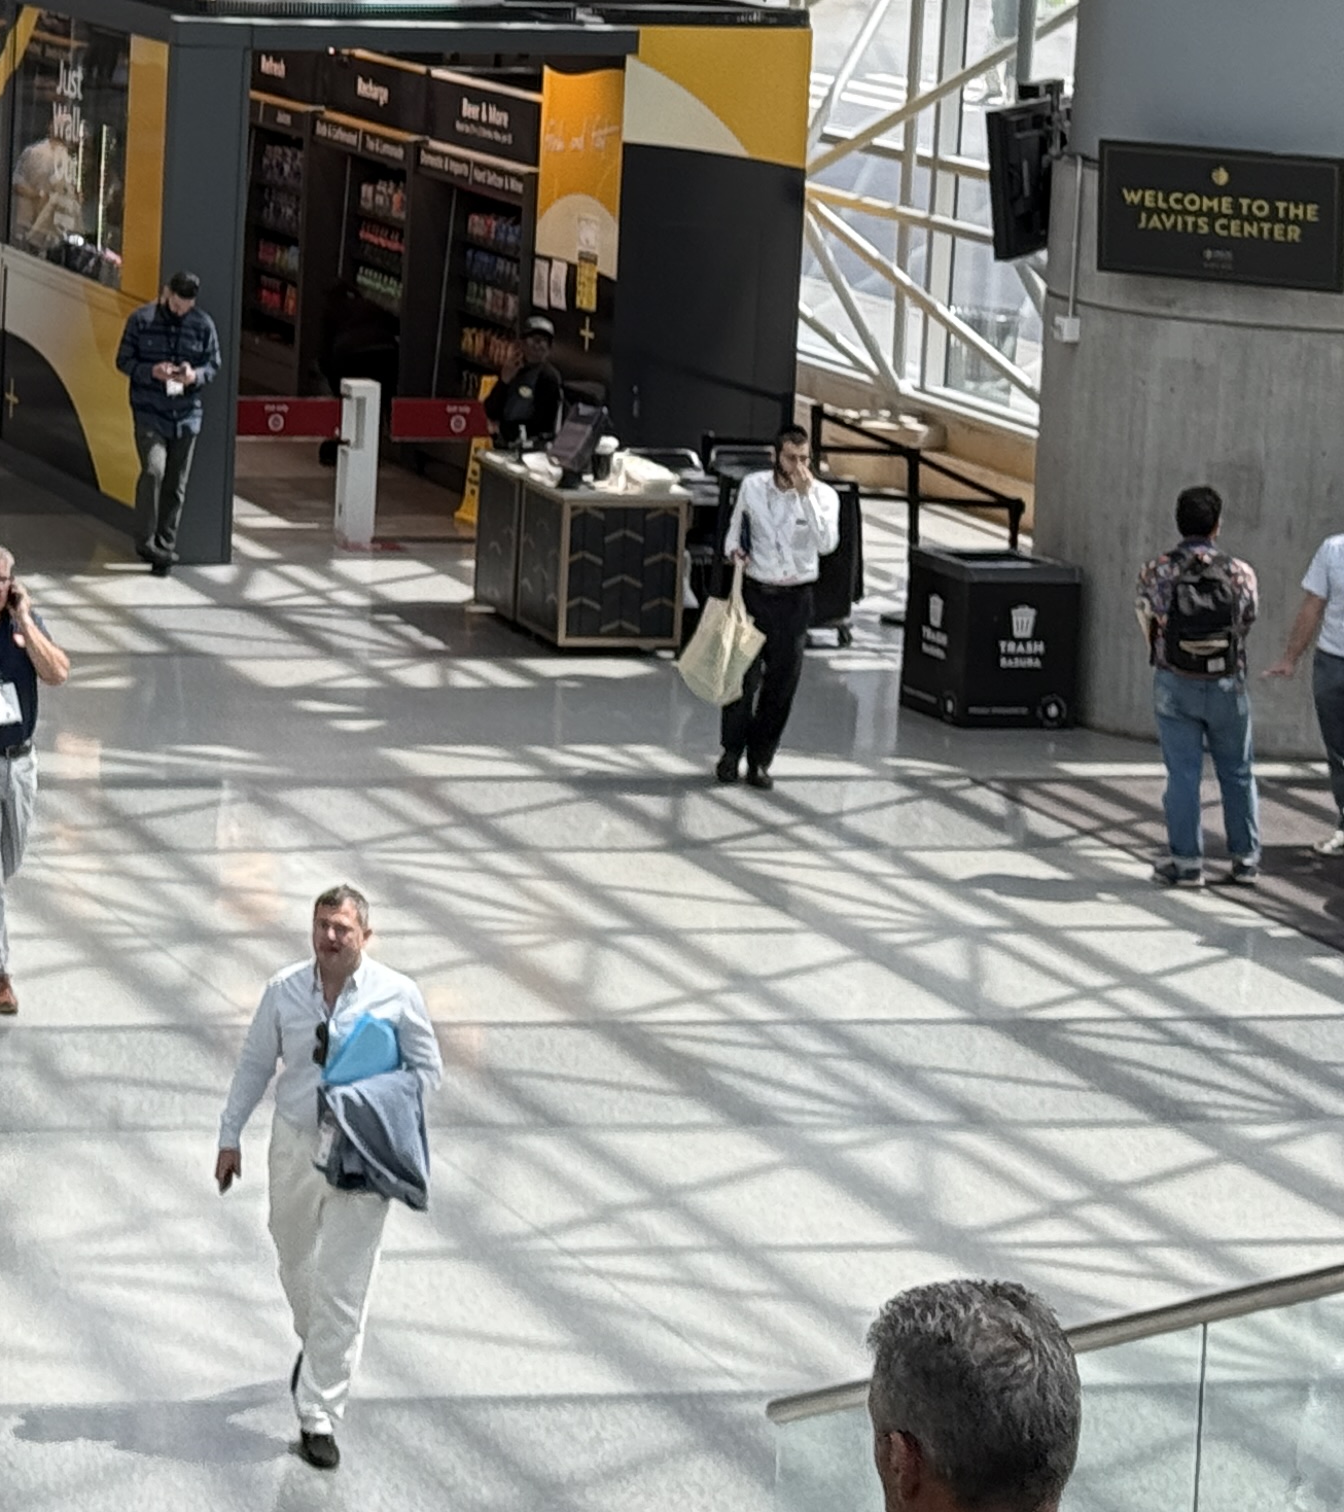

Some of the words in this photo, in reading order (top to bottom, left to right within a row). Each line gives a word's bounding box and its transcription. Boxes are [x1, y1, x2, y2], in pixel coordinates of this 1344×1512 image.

[55, 58, 84, 101] Just
[462, 96, 480, 121] Beer
[488, 103, 510, 129] More
[1121, 187, 1234, 216] WELCOME
[1238, 197, 1269, 219] TO
[1275, 200, 1320, 223] THE
[1137, 210, 1210, 236] JAVITS
[1214, 216, 1303, 244] CENTER
[997, 640, 1045, 656] TRASH
